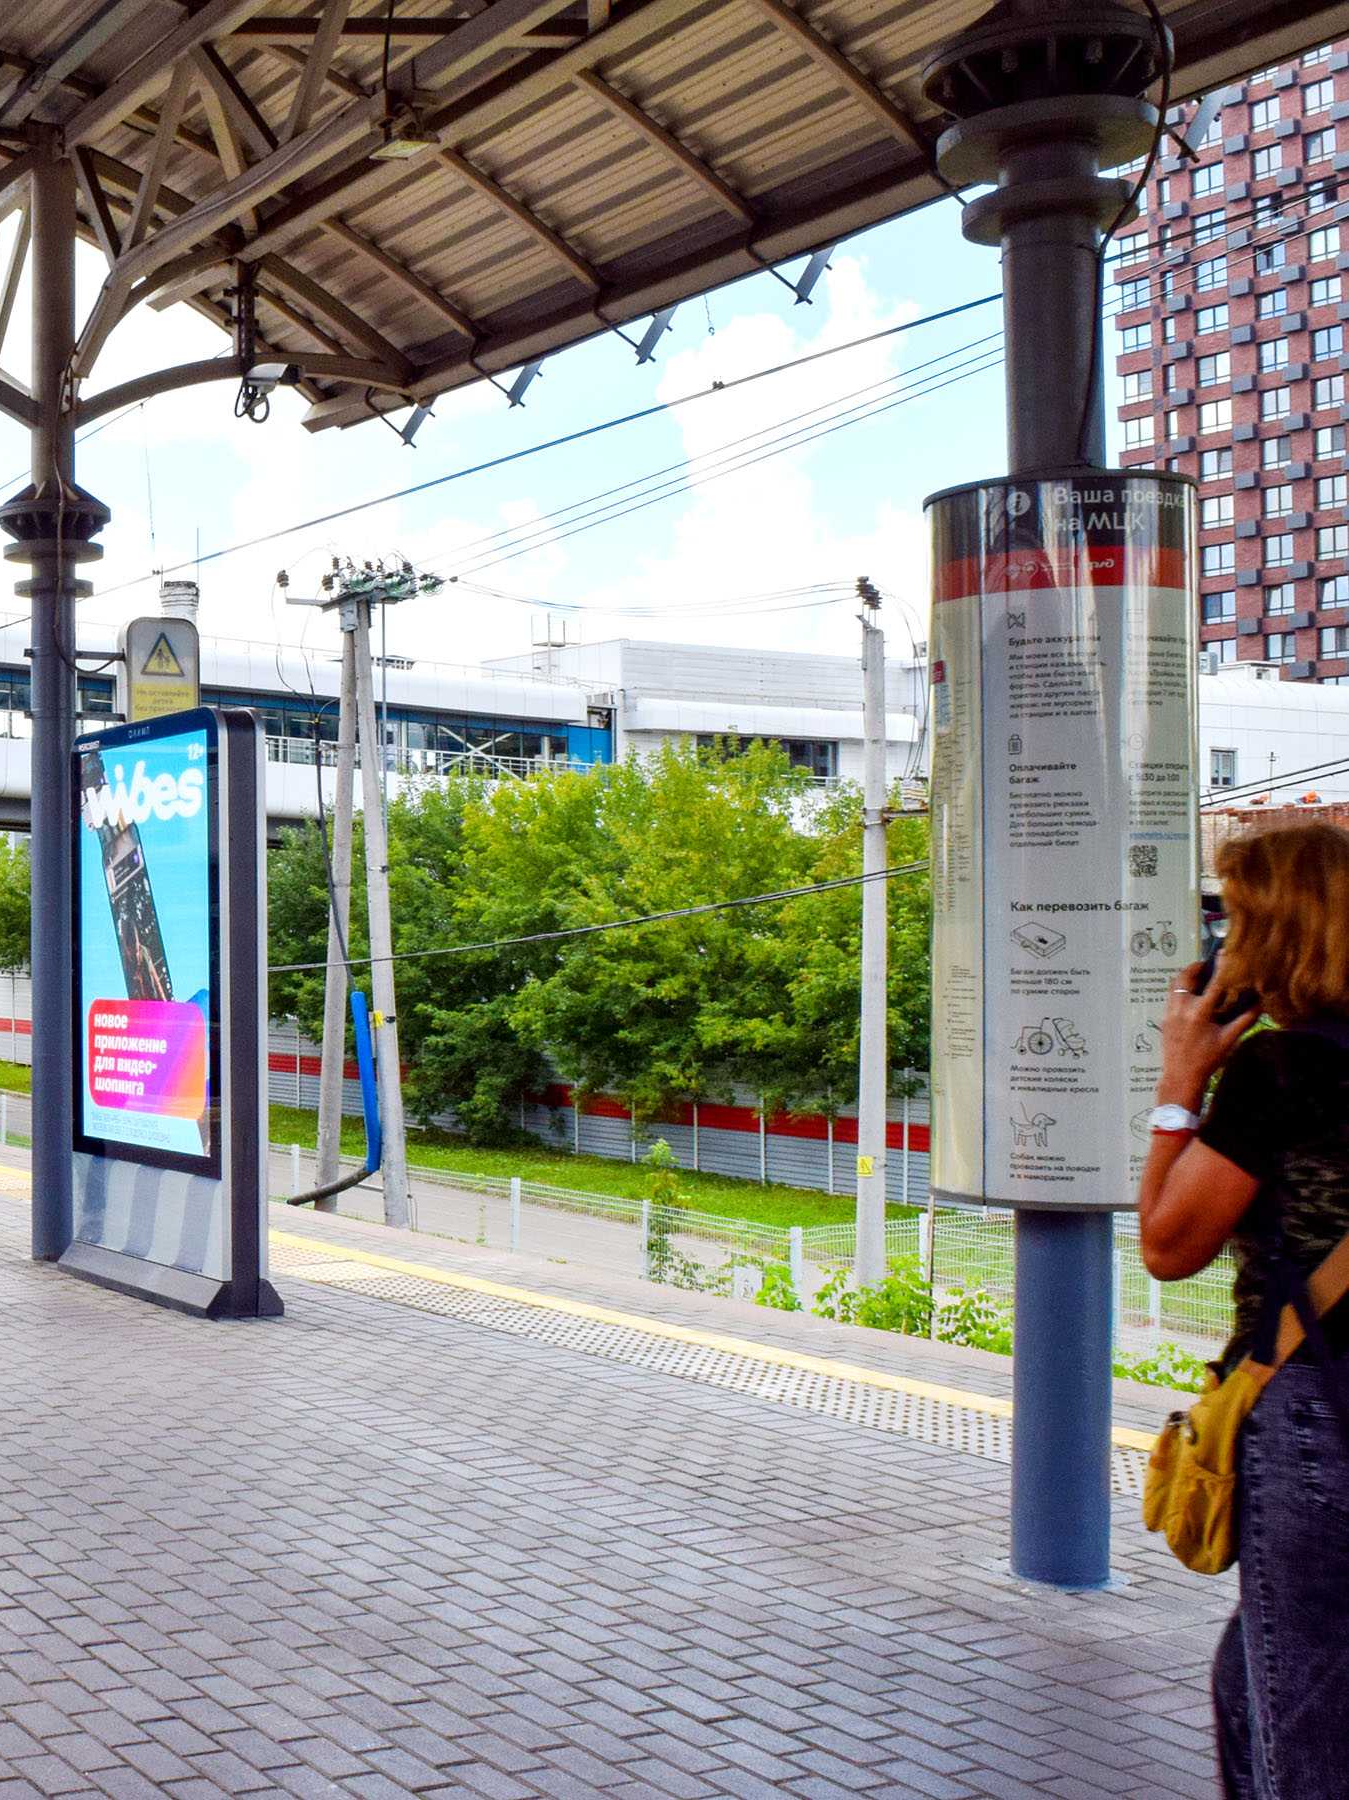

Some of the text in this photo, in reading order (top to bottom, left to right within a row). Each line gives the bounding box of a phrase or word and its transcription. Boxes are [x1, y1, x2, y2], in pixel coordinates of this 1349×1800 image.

[1053, 487, 1114, 505] Ваша
[1054, 512, 1145, 532] на МЦК
[1008, 637, 1043, 647] Будьте
[188, 743, 204, 760] 12+
[1009, 762, 1077, 772] Оплачивайте
[1009, 776, 1040, 784] багаж
[86, 760, 204, 829] vibes
[1010, 900, 1149, 914] Как перевозить багаж
[1010, 967, 1091, 977] Багаж должен быть
[1044, 977, 1059, 985] 180
[94, 1014, 128, 1029] новое
[94, 1035, 167, 1054] приложение
[94, 1056, 158, 1077] для видео-
[1010, 1065, 1086, 1074] Можно провозить
[94, 1077, 145, 1096] шопинга
[1069, 1086, 1099, 1094] кресла
[1010, 1152, 1035, 1161] Собак
[1010, 1163, 1051, 1171] провозить
[1023, 1174, 1075, 1182] наморднике
